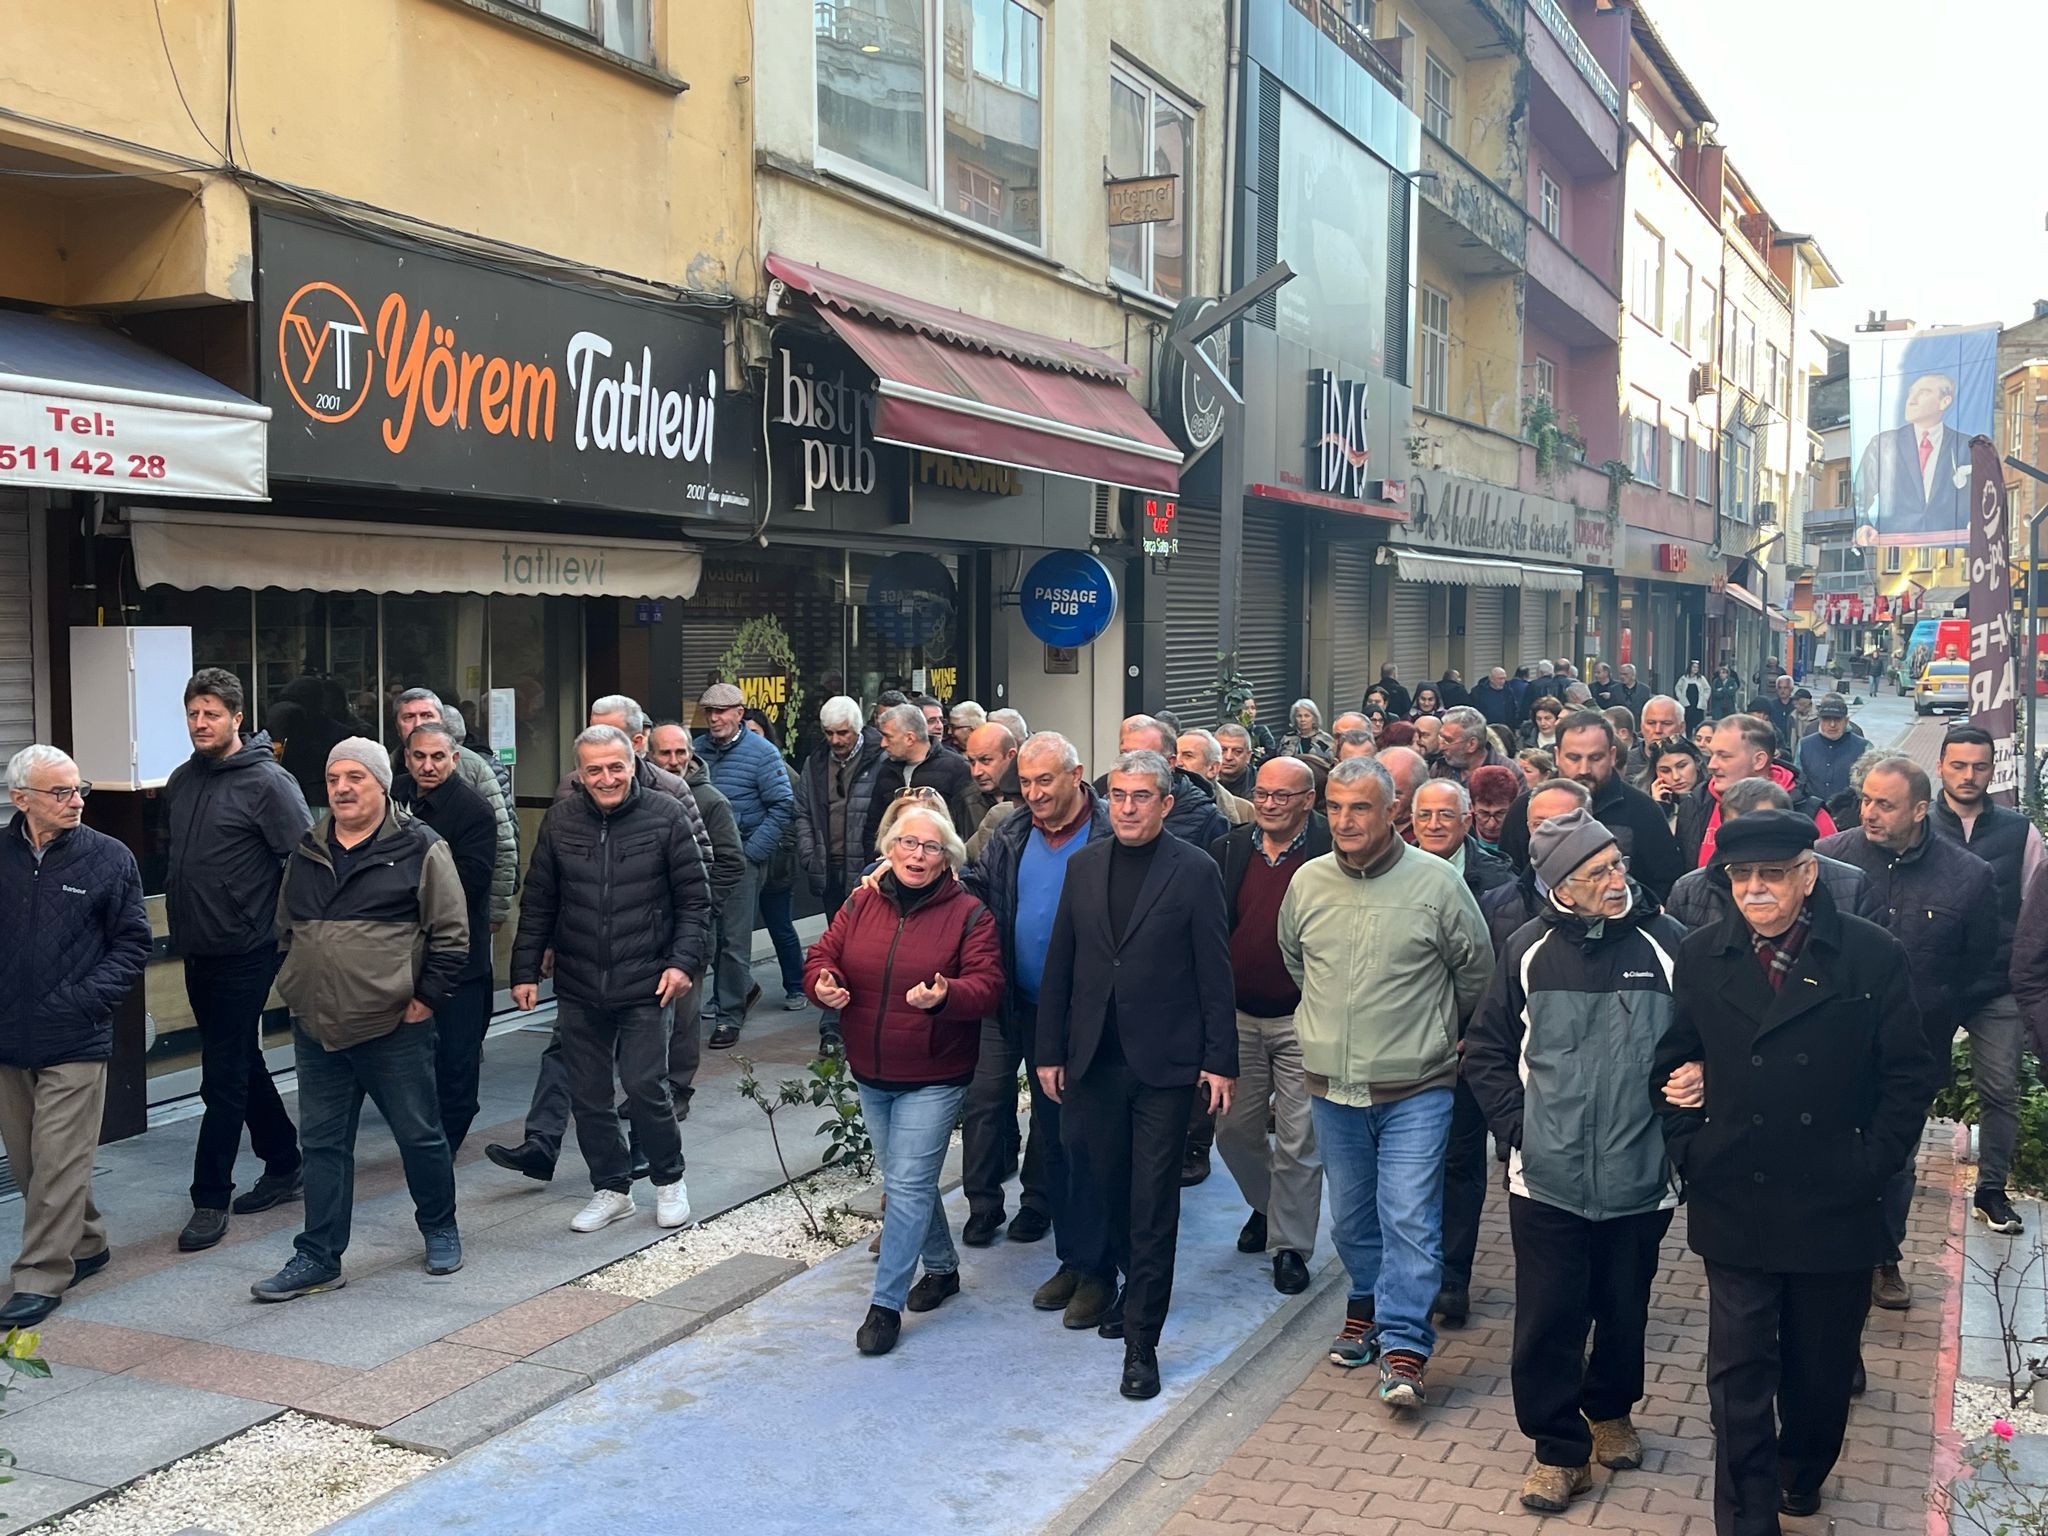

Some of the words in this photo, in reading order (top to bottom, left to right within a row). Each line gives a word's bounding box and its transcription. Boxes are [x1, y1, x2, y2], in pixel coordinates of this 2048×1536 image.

[376, 292, 557, 454] Yörem
[315, 393, 341, 410] 2001
[46, 406, 115, 437] Tel:
[70, 450, 115, 476] 42
[128, 454, 166, 479] 28
[797, 420, 876, 512] pub
[1035, 587, 1097, 604] PASSAGE
[1050, 602, 1079, 616] PUB
[739, 676, 786, 703] WINE
[930, 667, 957, 687] WINE
